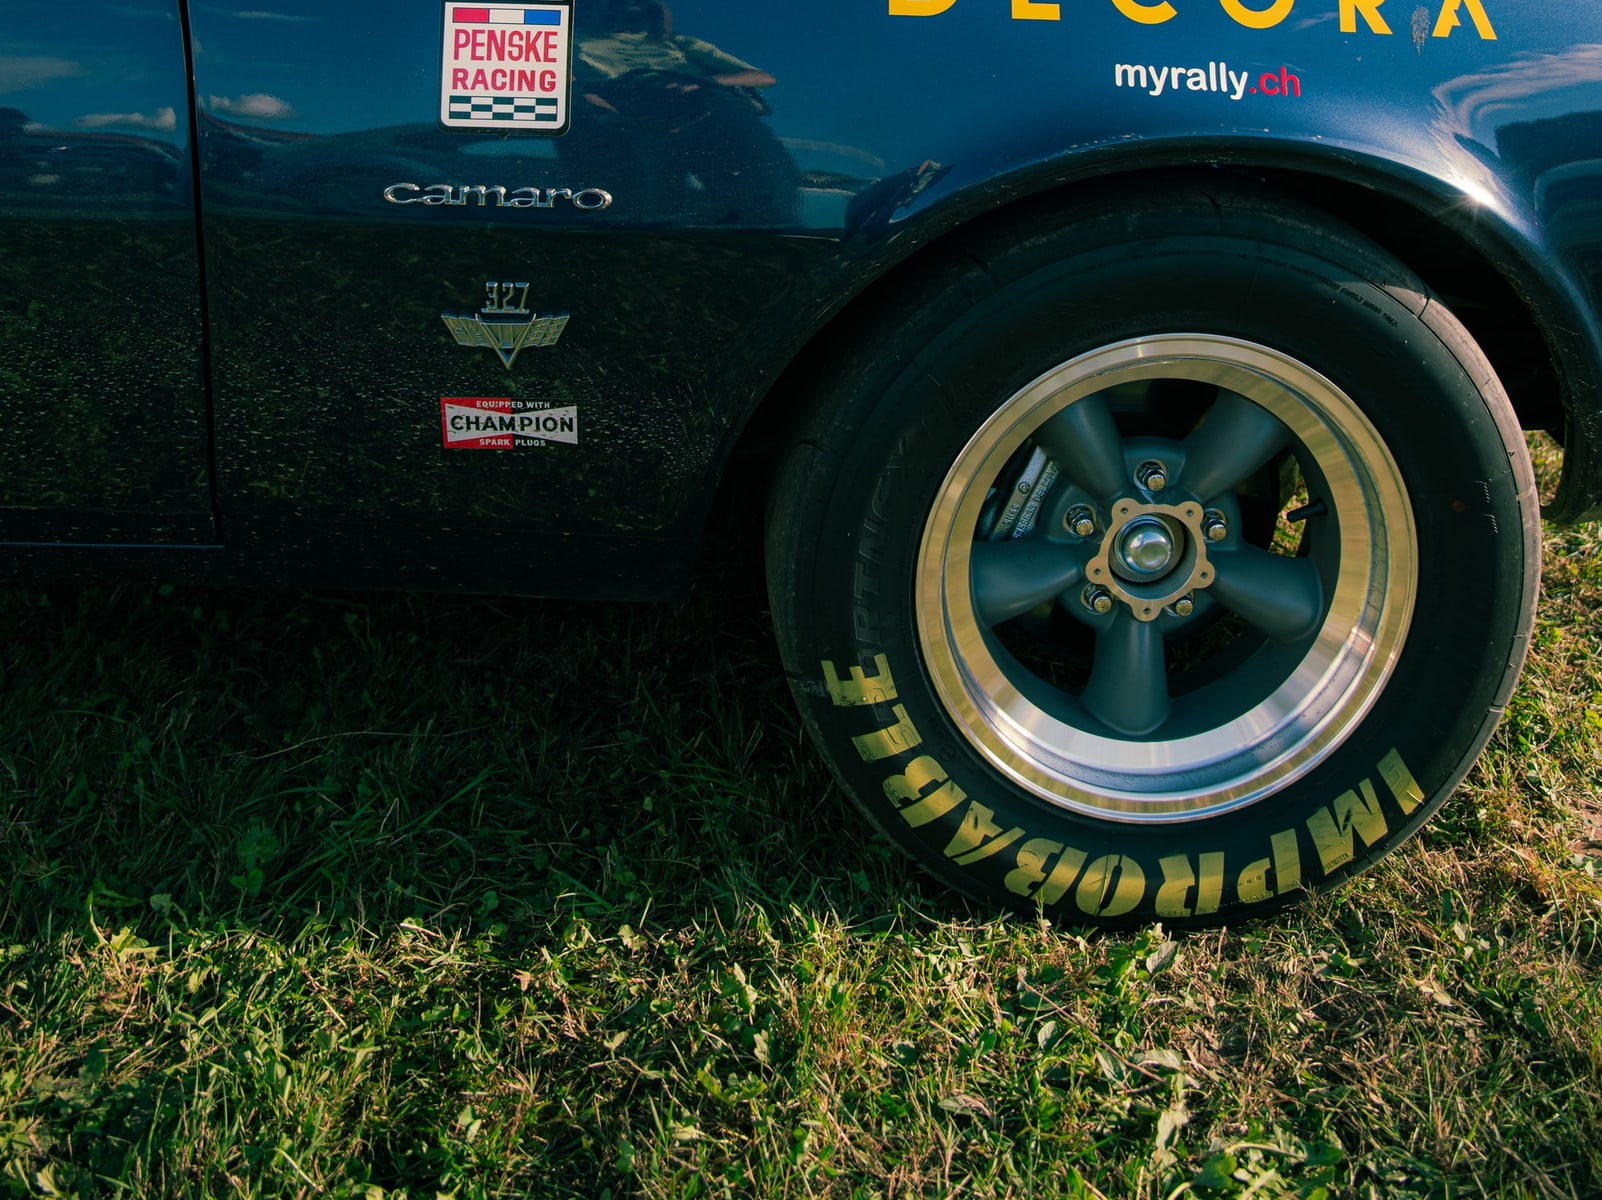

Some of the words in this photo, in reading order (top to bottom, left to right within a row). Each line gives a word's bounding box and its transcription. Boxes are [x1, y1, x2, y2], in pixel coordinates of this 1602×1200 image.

[453, 28, 558, 63] PENSKE
[451, 67, 557, 93] RACING
[1115, 60, 1301, 100] myrally.ch
[383, 182, 613, 210] camaro
[485, 281, 530, 312] 327
[476, 400, 524, 409] EQUIPPED
[526, 400, 550, 409] WITH
[450, 415, 574, 433] CHAMPION
[479, 437, 511, 447] SPARK
[515, 438, 546, 447] PLUGS
[820, 652, 1427, 918] IMPROBABLE
